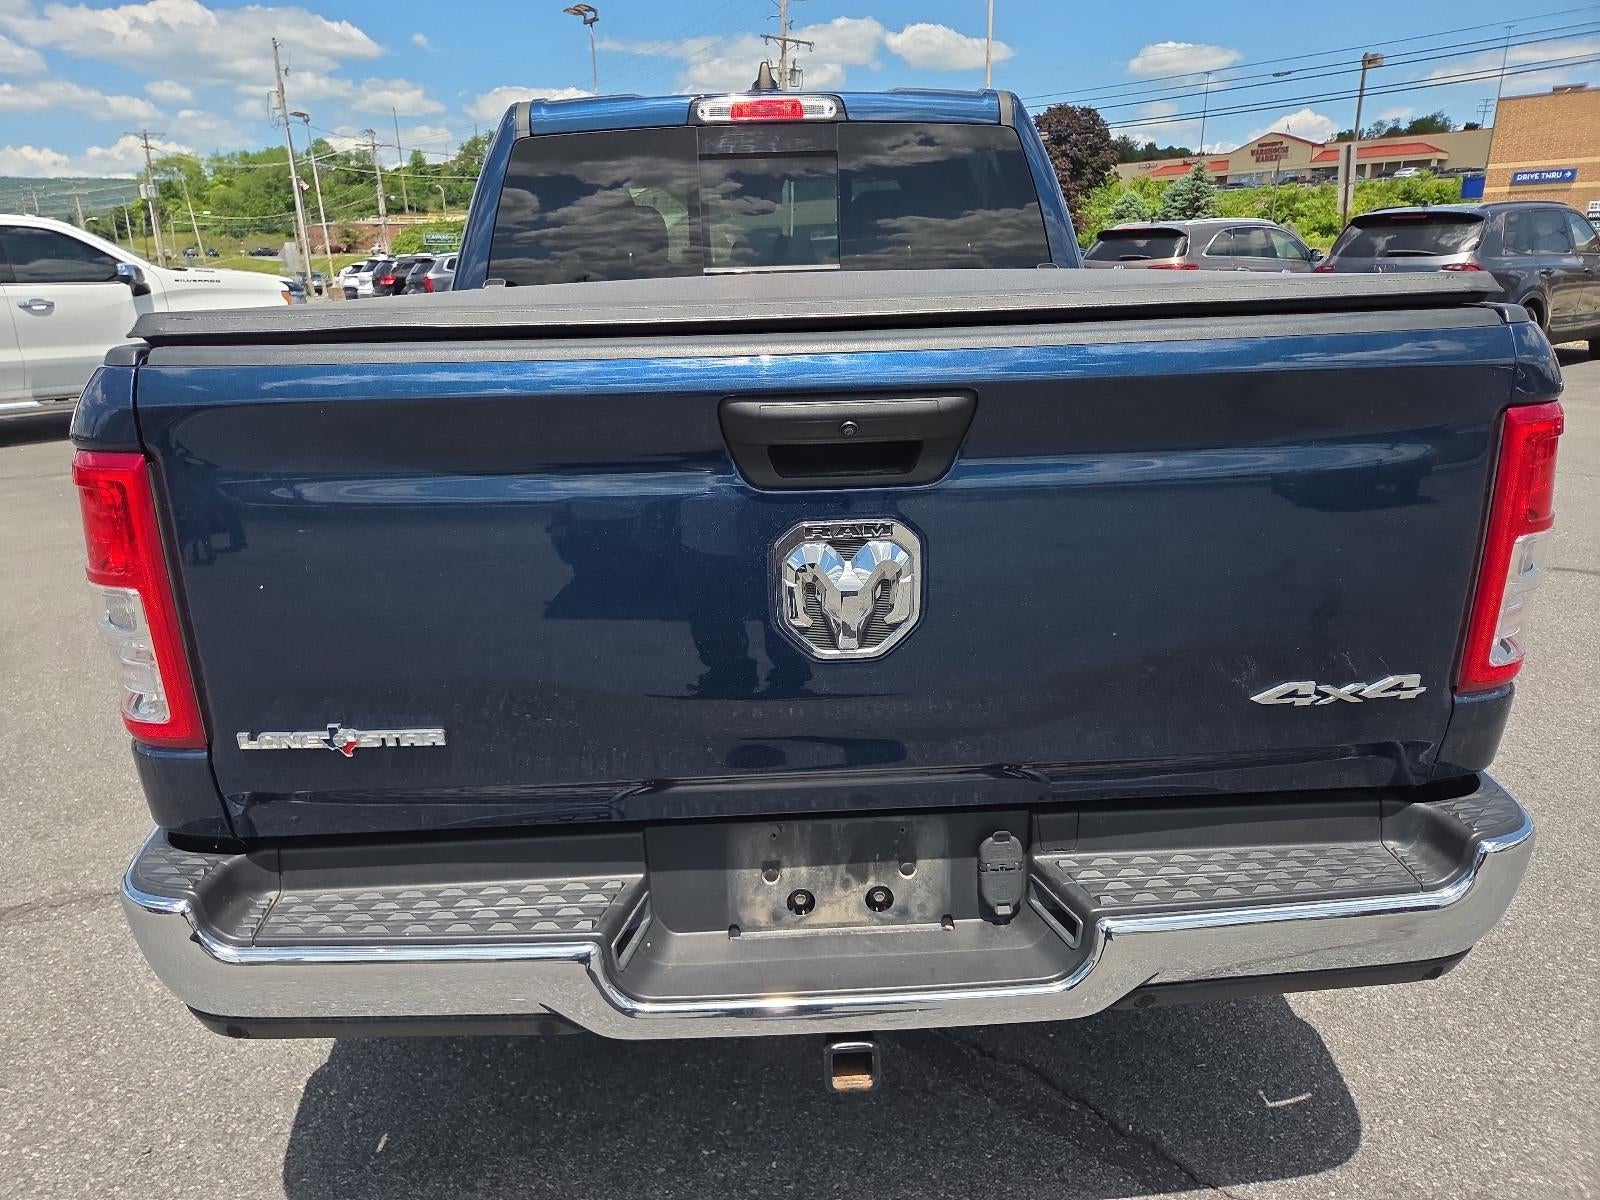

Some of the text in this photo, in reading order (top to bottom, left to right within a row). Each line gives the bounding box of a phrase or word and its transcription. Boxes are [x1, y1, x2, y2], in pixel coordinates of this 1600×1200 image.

[1517, 171, 1563, 181] DRIVE THRU
[804, 524, 893, 539] RAM
[236, 728, 447, 750] LONE STAR
